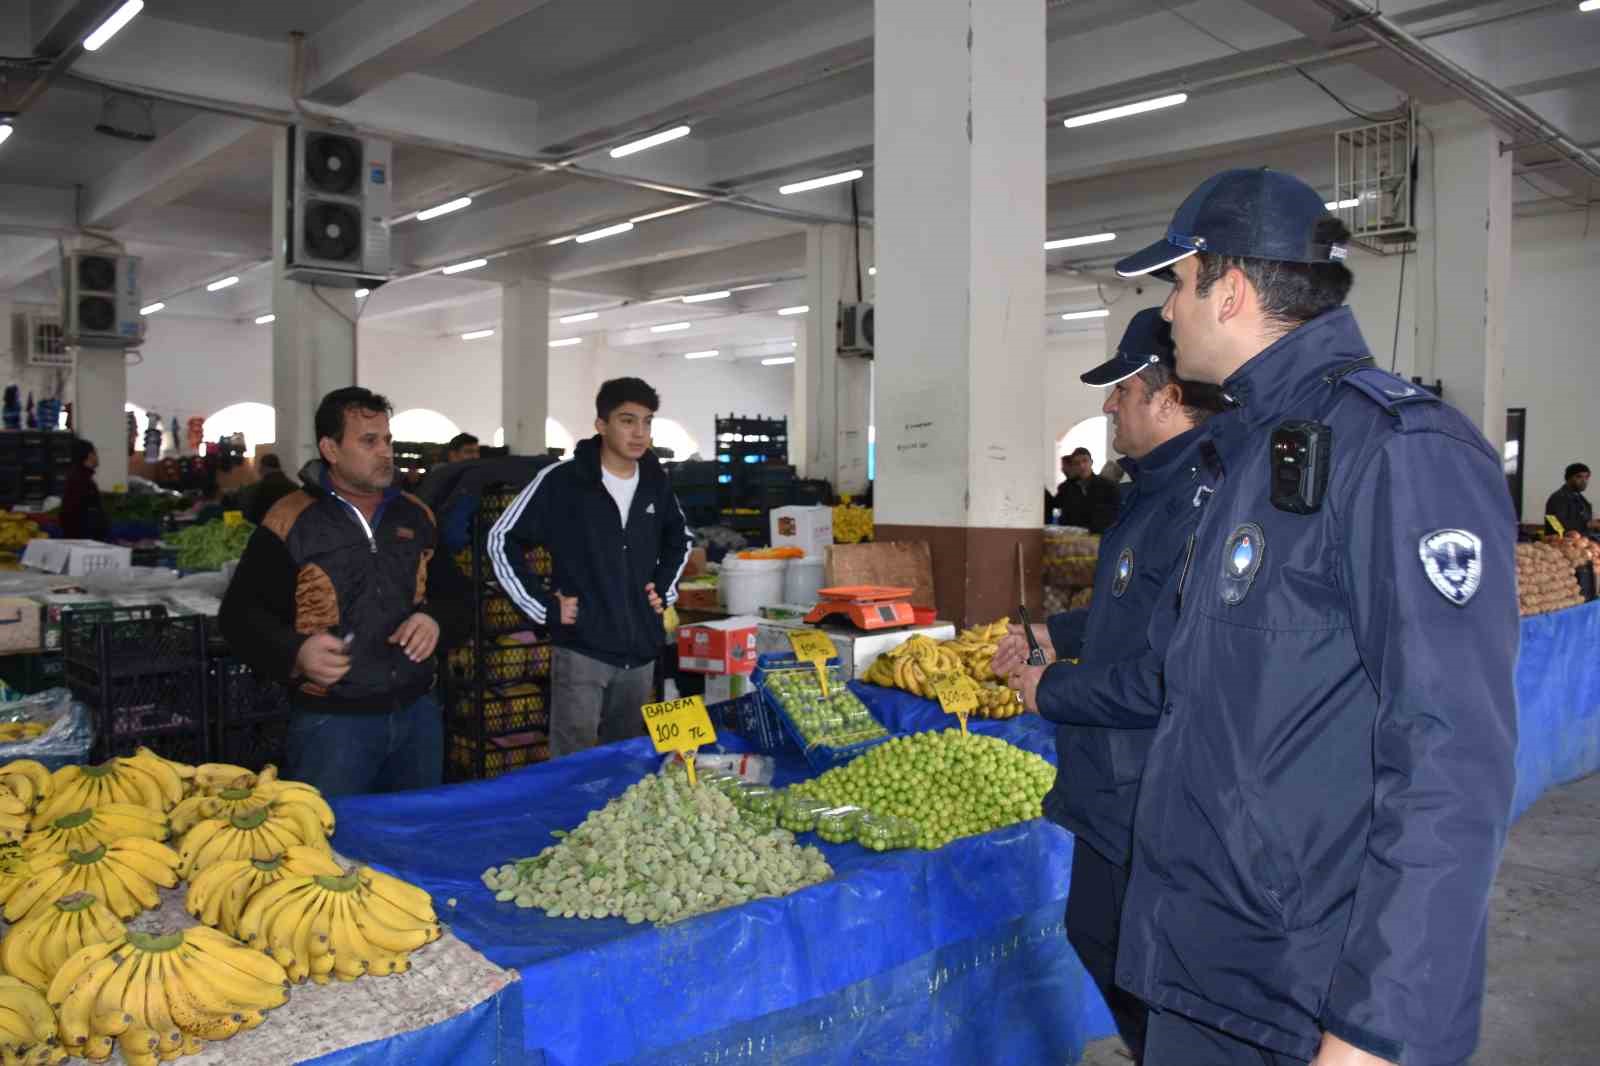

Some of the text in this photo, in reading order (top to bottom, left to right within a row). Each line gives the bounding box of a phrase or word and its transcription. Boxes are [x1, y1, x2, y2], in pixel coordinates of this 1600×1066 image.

[645, 698, 695, 718] BADEM
[656, 723, 706, 743] 100 TL
